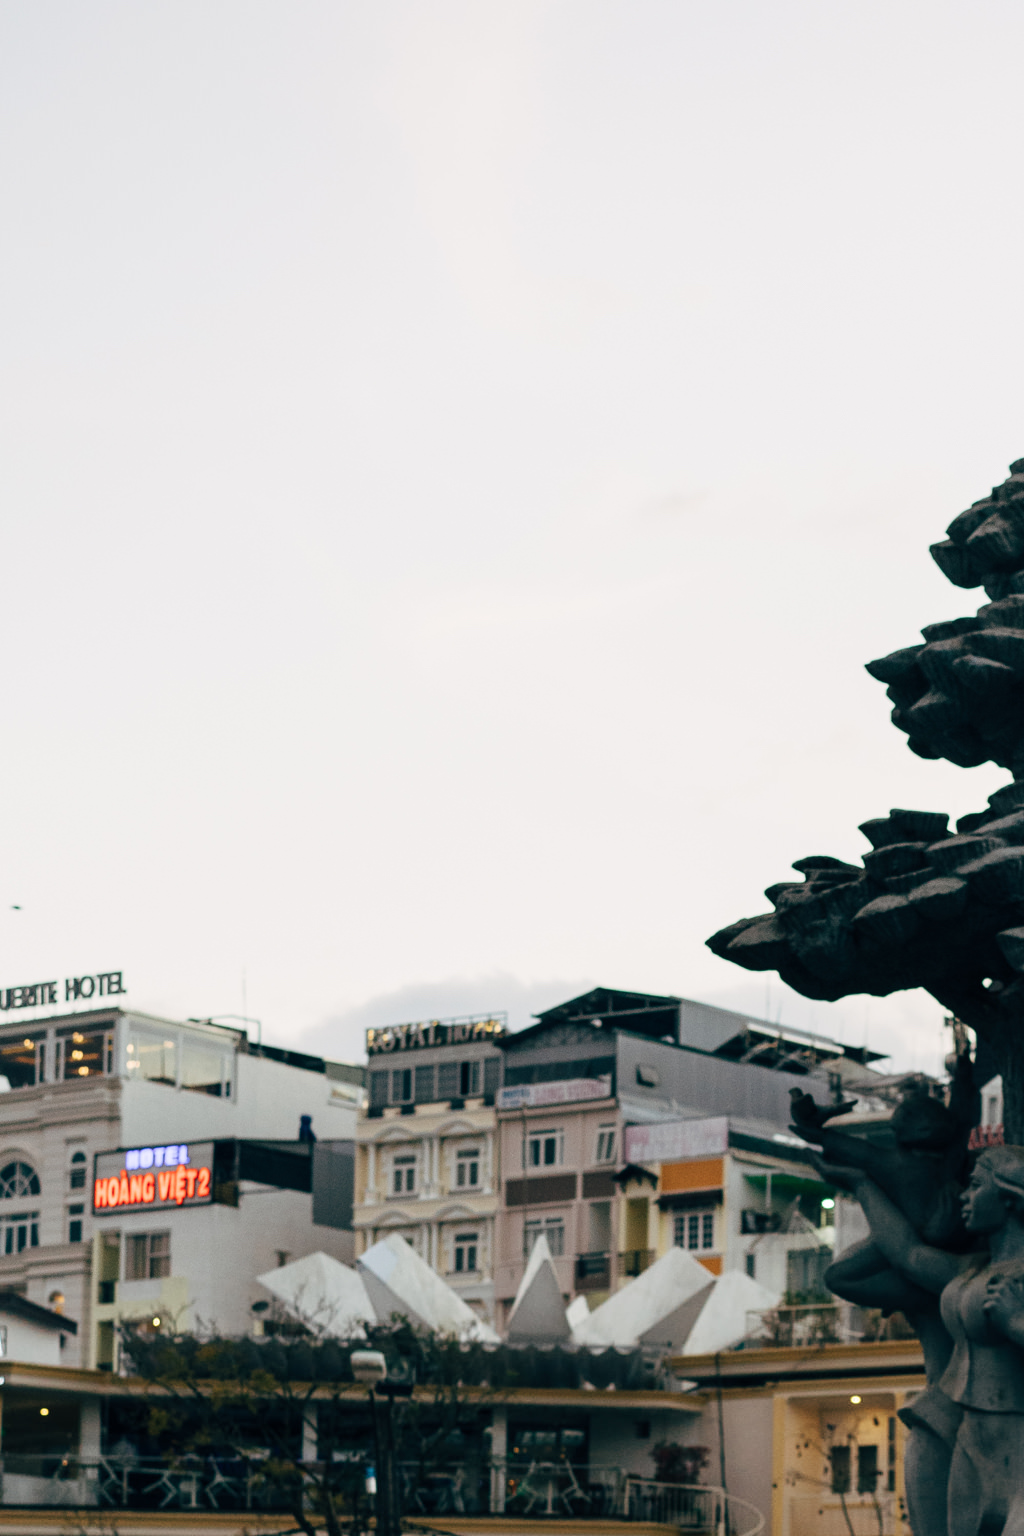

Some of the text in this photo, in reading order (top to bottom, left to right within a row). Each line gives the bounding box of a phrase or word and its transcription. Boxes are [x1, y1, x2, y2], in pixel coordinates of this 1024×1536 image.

[65, 971, 127, 1002] HOTEL
[125, 1144, 190, 1171] HOTEL
[94, 1169, 155, 1208] HOÀNG
